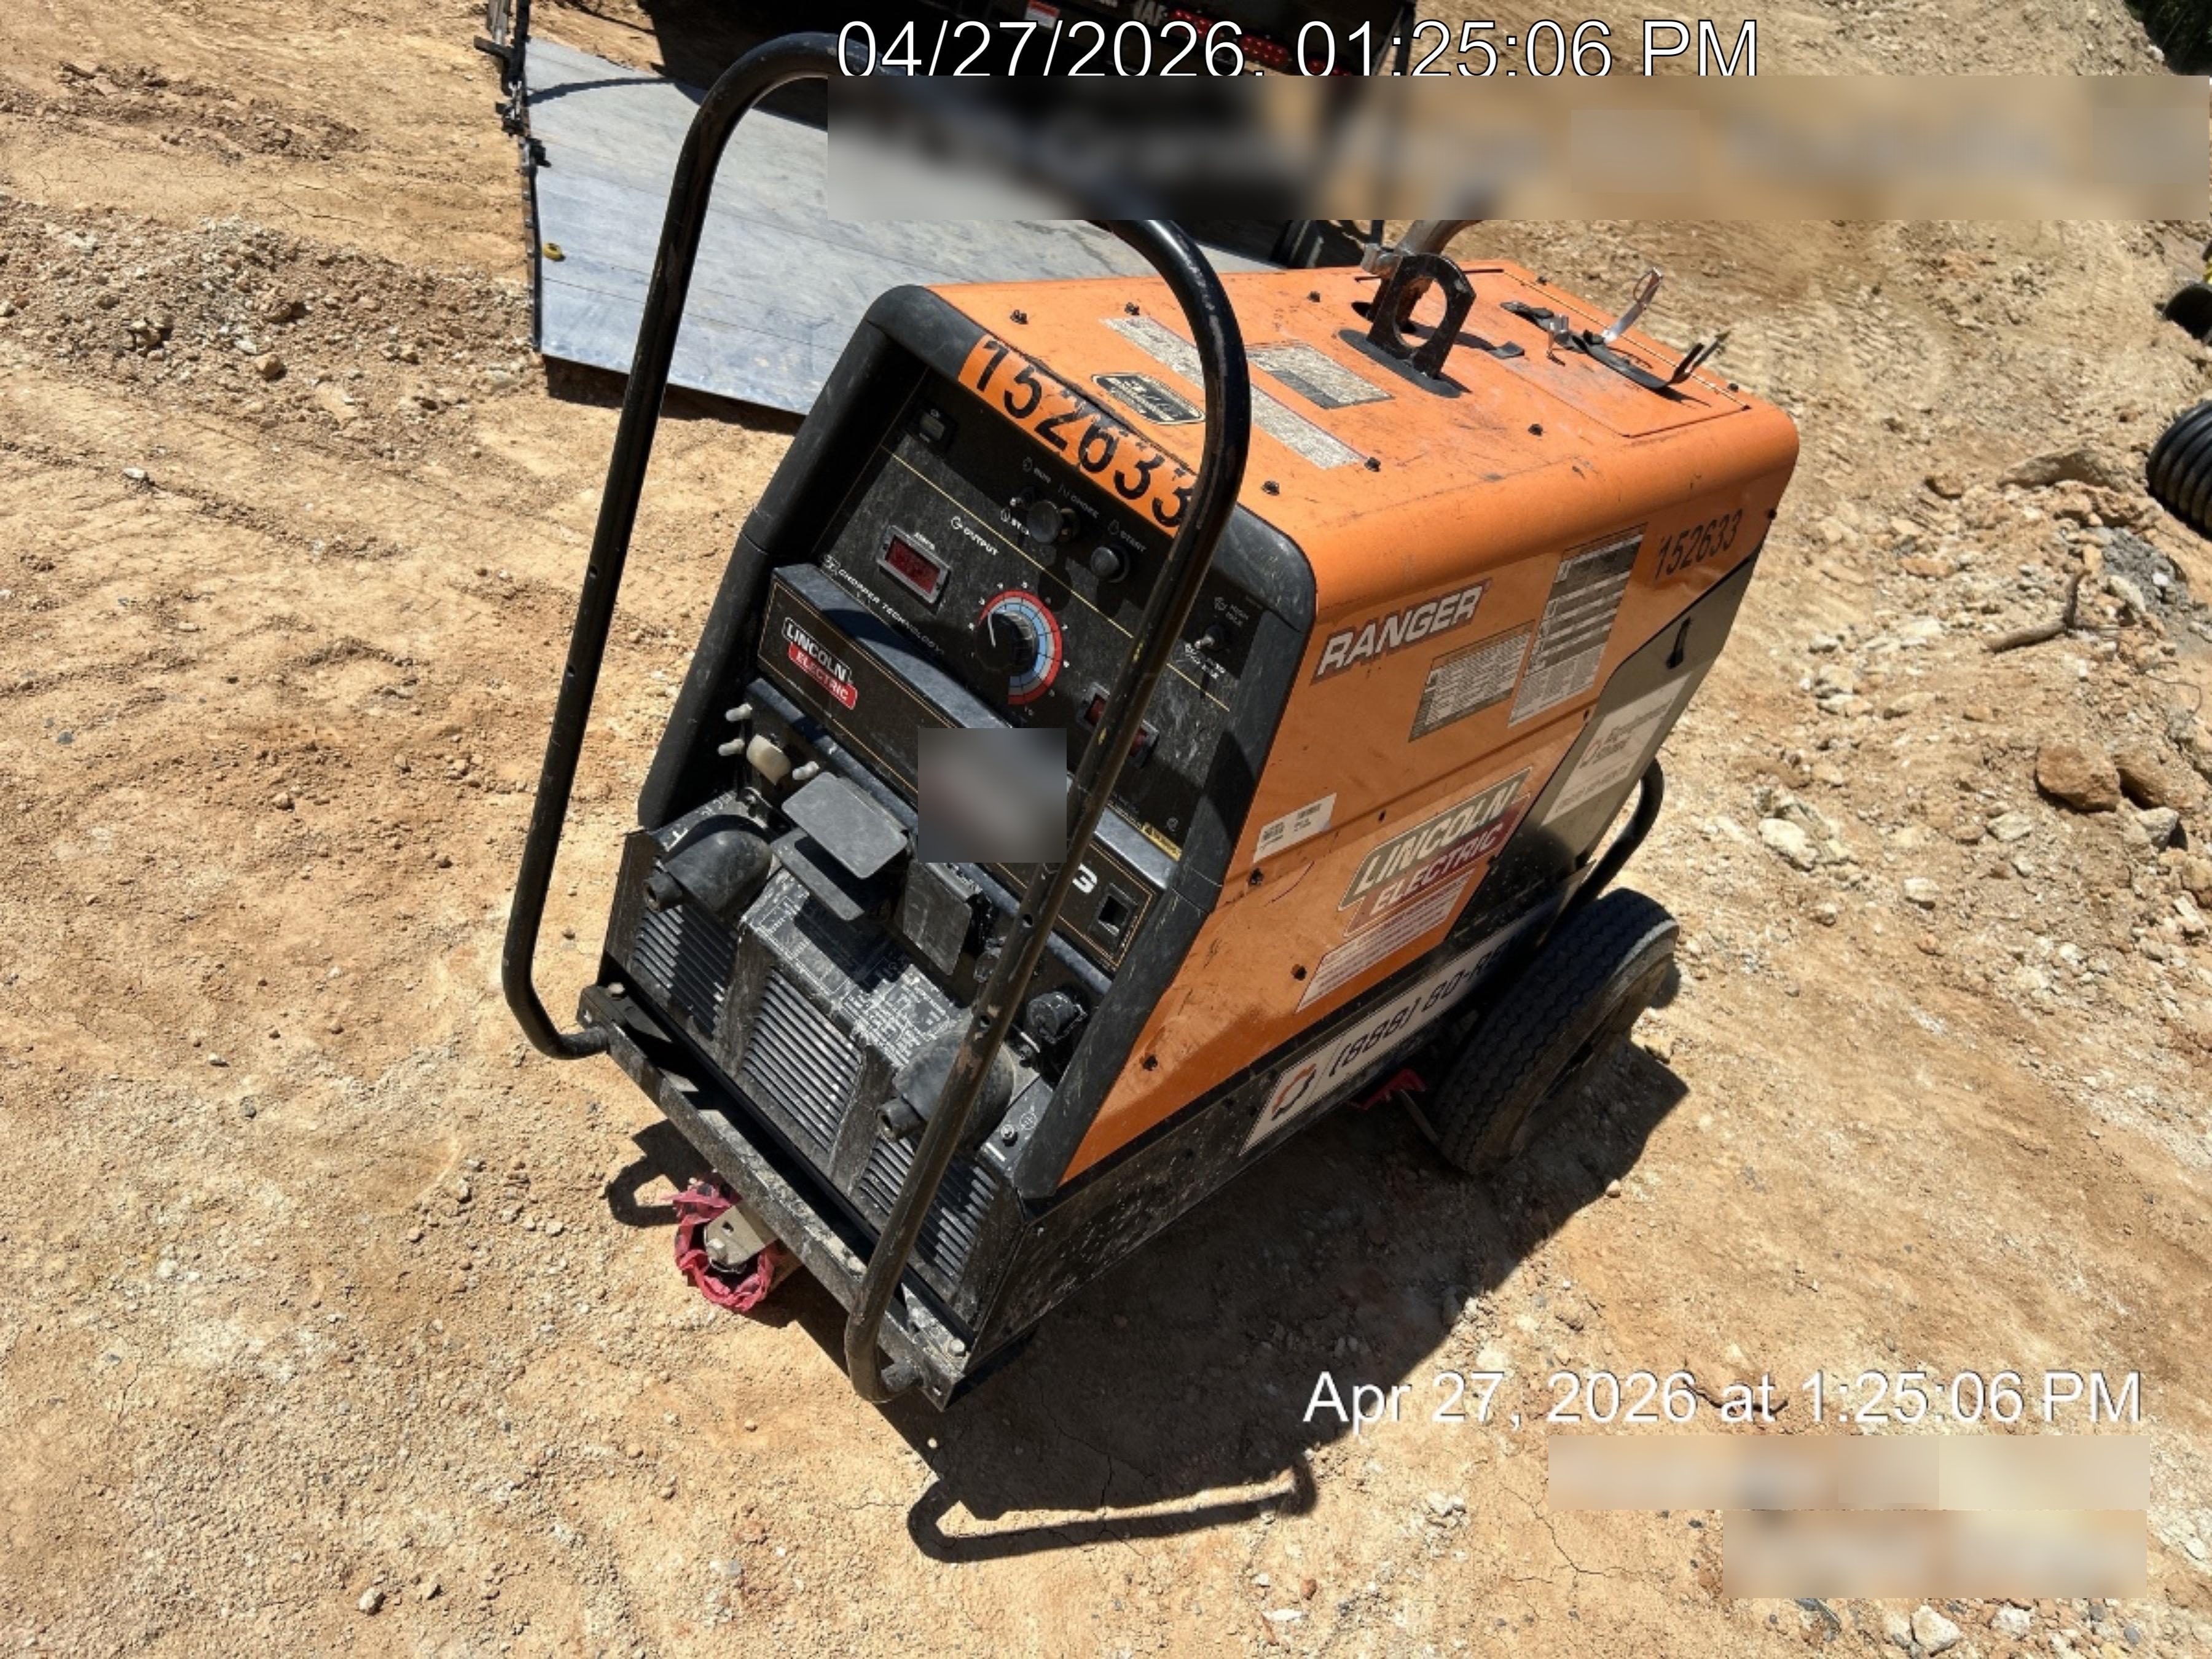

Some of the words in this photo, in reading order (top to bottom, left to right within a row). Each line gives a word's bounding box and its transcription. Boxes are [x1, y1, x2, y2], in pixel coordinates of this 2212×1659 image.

[963, 527, 999, 556] OUTPUT
[1011, 518, 1029, 536] STO
[1655, 508, 1743, 579] 152633
[787, 622, 847, 682] LINCOLN
[1317, 586, 1483, 675] RANGER
[796, 652, 849, 700] ELECTRIC
[1354, 781, 1519, 896] LINCOLN
[1369, 823, 1503, 916] ELECTRIC
[1329, 997, 1422, 1077] (888)
